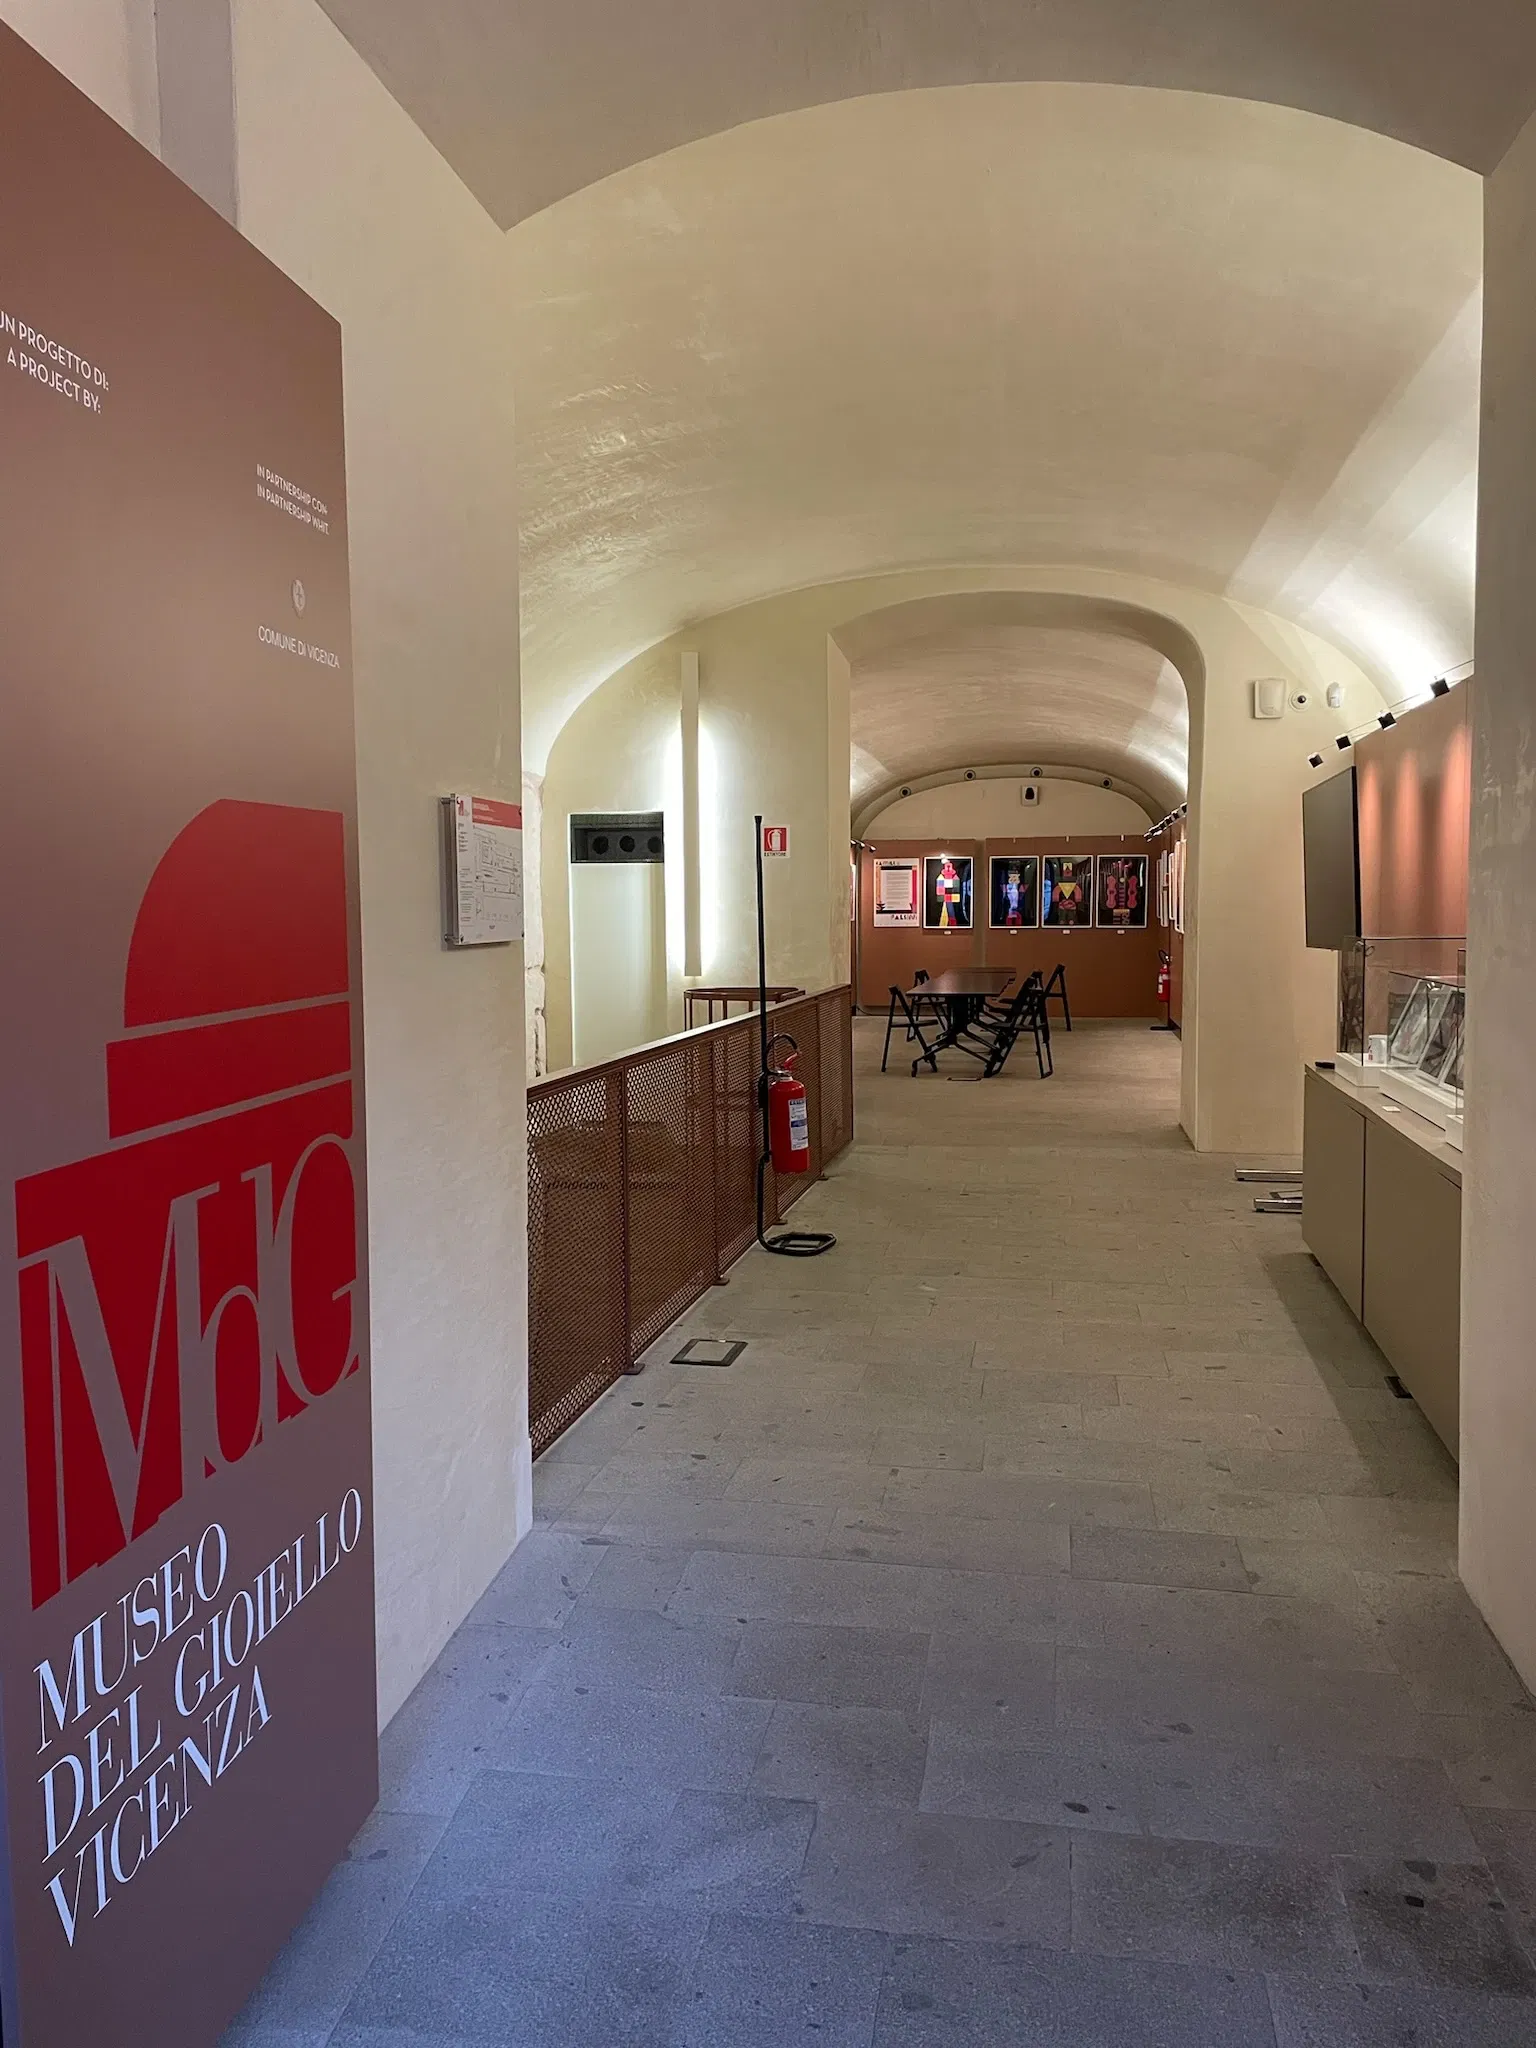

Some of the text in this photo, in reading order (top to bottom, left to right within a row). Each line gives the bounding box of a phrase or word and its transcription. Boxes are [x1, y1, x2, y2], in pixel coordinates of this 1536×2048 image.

[7, 346, 101, 414] A PROJECT BY:
[18, 321, 92, 380] PROGETTO
[93, 366, 109, 391] DI:
[256, 463, 265, 479] IN
[265, 468, 311, 505] PARTNERSHIP
[256, 483, 265, 499] IN
[265, 488, 311, 524] PARTNERSHIP
[258, 625, 341, 669] COMUNE DI VICENZA
[33, 1523, 228, 1754] MUSEO
[37, 1488, 363, 1864] DEL GIOIELLO
[44, 1665, 272, 1948] VICENZA
